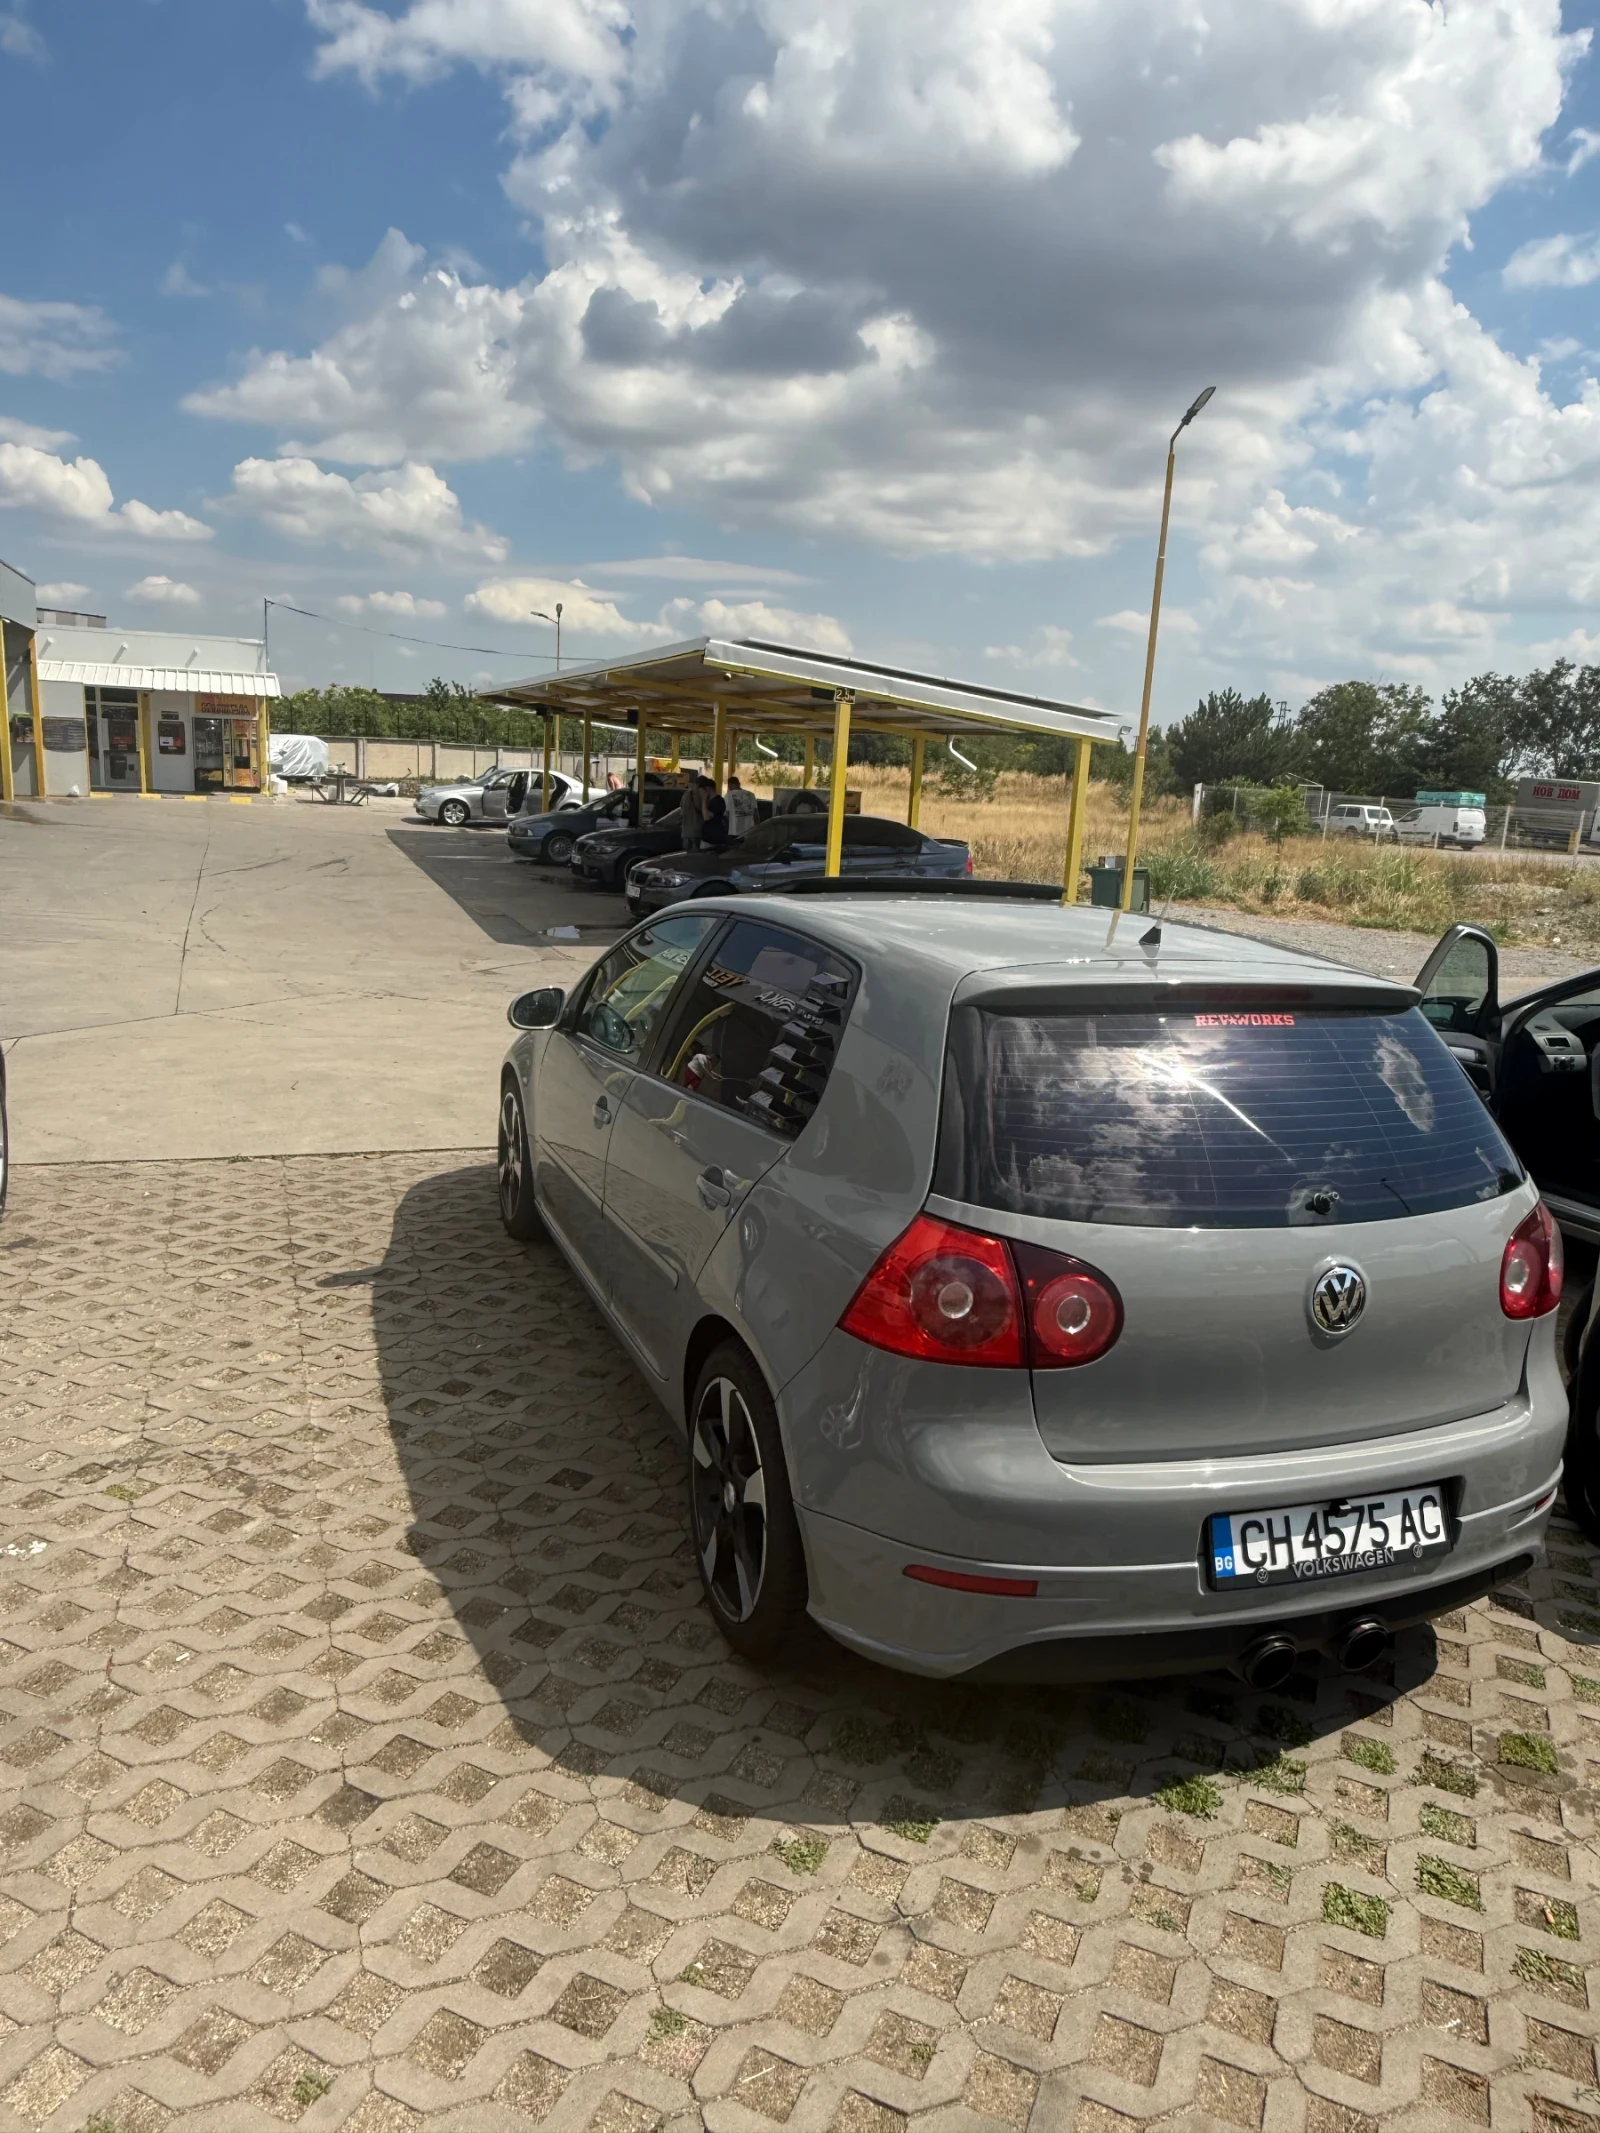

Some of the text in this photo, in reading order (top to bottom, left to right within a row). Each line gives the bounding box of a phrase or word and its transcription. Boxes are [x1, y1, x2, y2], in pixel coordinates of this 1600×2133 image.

[1532, 786, 1581, 800] НОВ ДОМ
[1215, 1556, 1234, 1571] BG
[1293, 1546, 1395, 1578] VOLKSWAGEN
